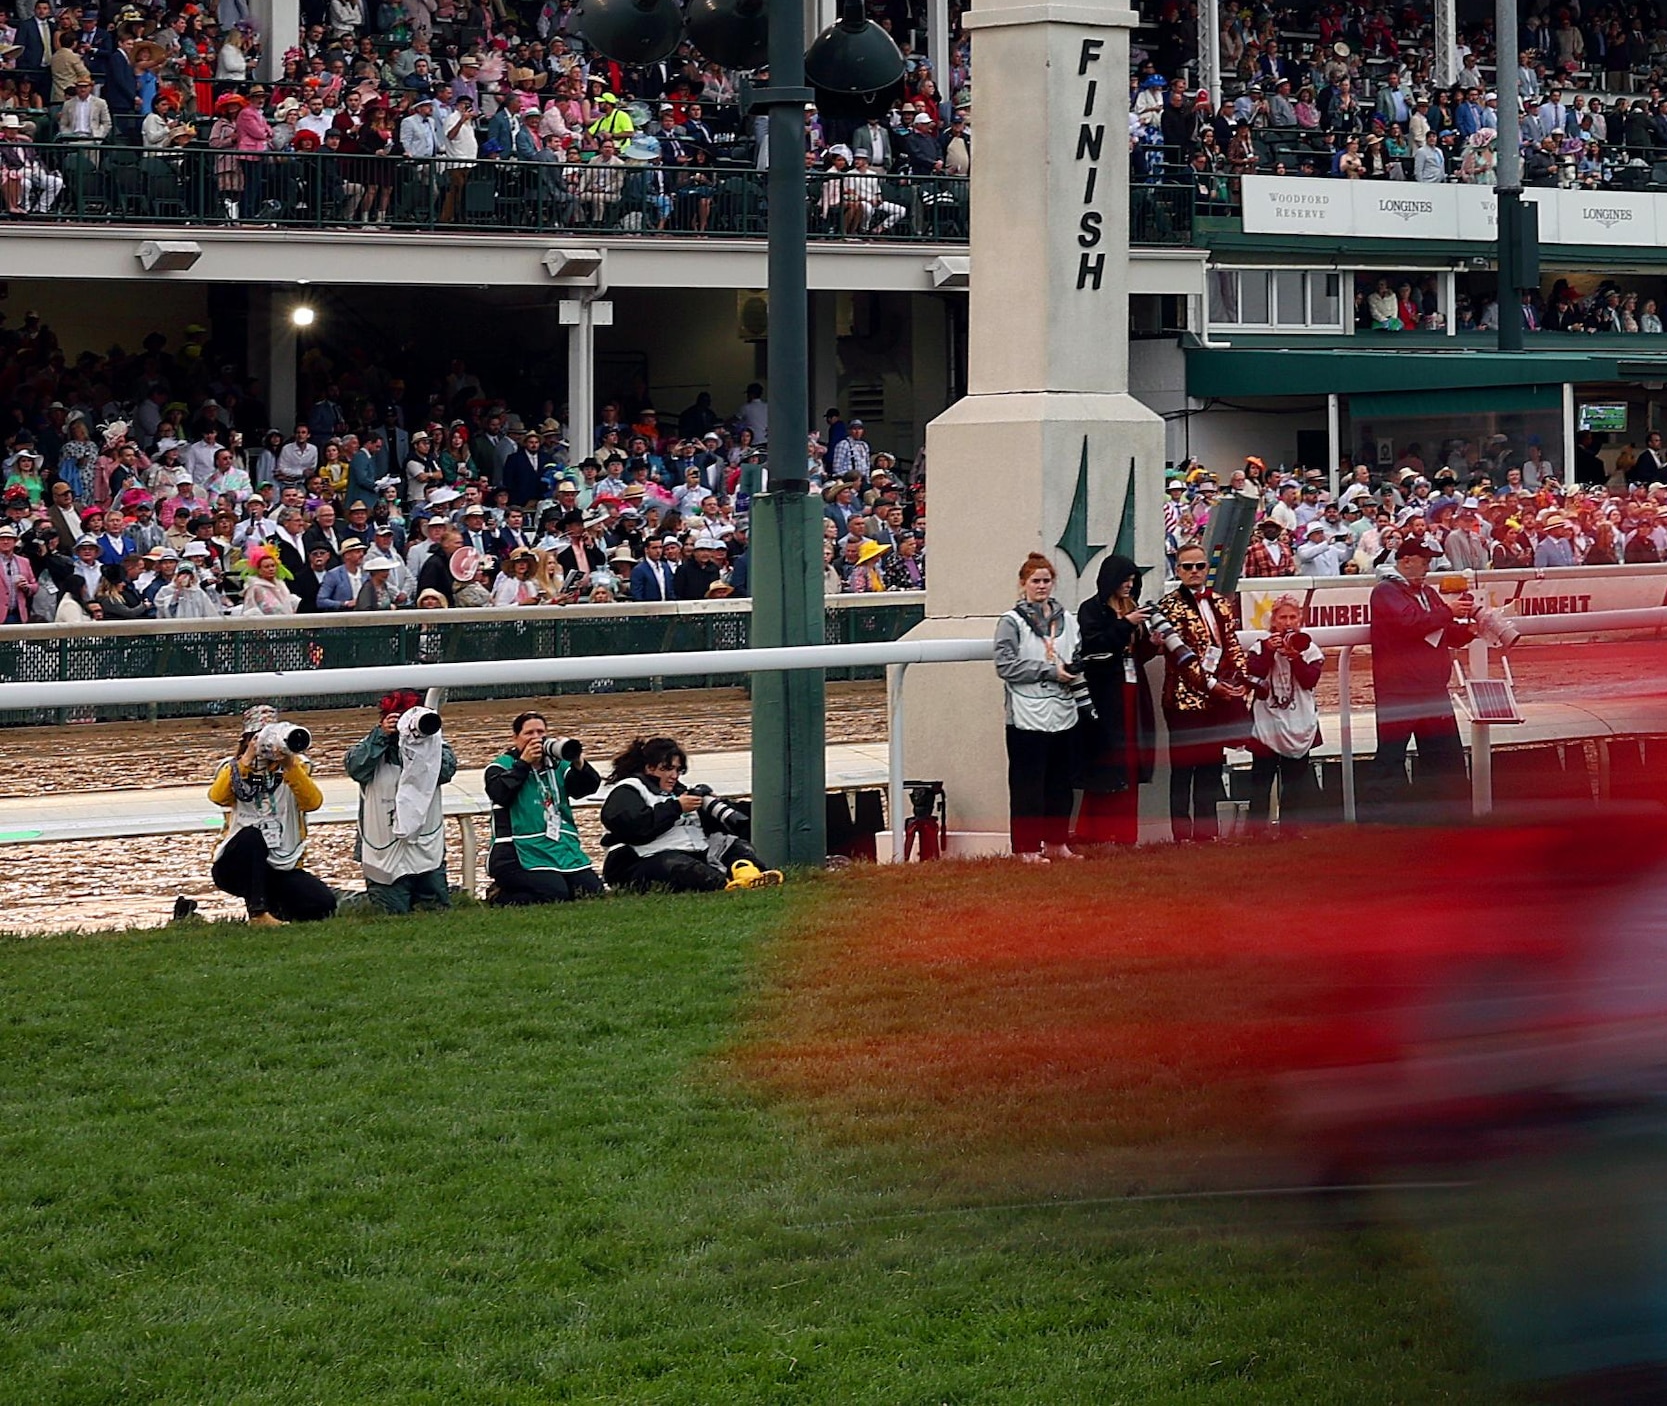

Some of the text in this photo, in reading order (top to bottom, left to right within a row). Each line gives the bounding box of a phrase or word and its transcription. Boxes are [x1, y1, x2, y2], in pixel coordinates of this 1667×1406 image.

[1075, 38, 1105, 291] FINISH
[1268, 192, 1330, 205] WOODFORD
[1379, 199, 1432, 213] LONGINES
[1276, 207, 1326, 219] RESERVE
[1583, 208, 1632, 221] LONGINES
[1303, 604, 1371, 628] UNBEL
